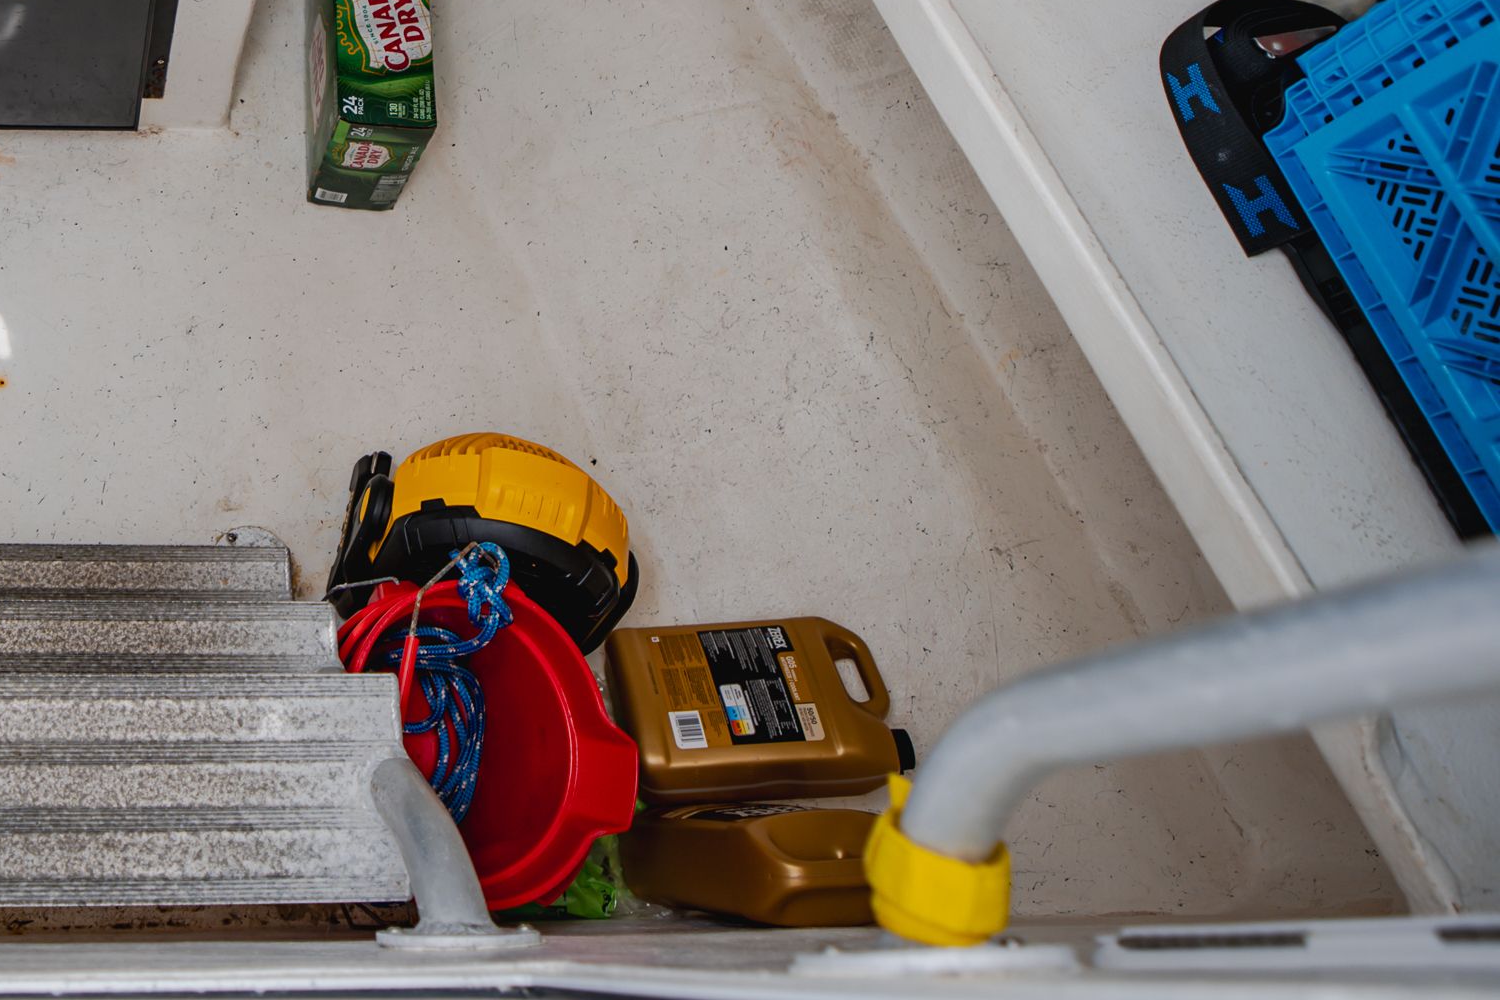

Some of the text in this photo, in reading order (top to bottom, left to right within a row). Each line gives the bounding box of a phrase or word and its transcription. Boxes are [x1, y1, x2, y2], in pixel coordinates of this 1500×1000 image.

[366, 24, 379, 44] SINCE
[343, 95, 358, 115] 24
[389, 103, 398, 116] 130
[350, 127, 367, 137] 24
[350, 141, 372, 169] CANADA
[367, 149, 382, 165] DRY
[767, 626, 788, 649] ZEREX
[807, 707, 818, 725] 50/50
